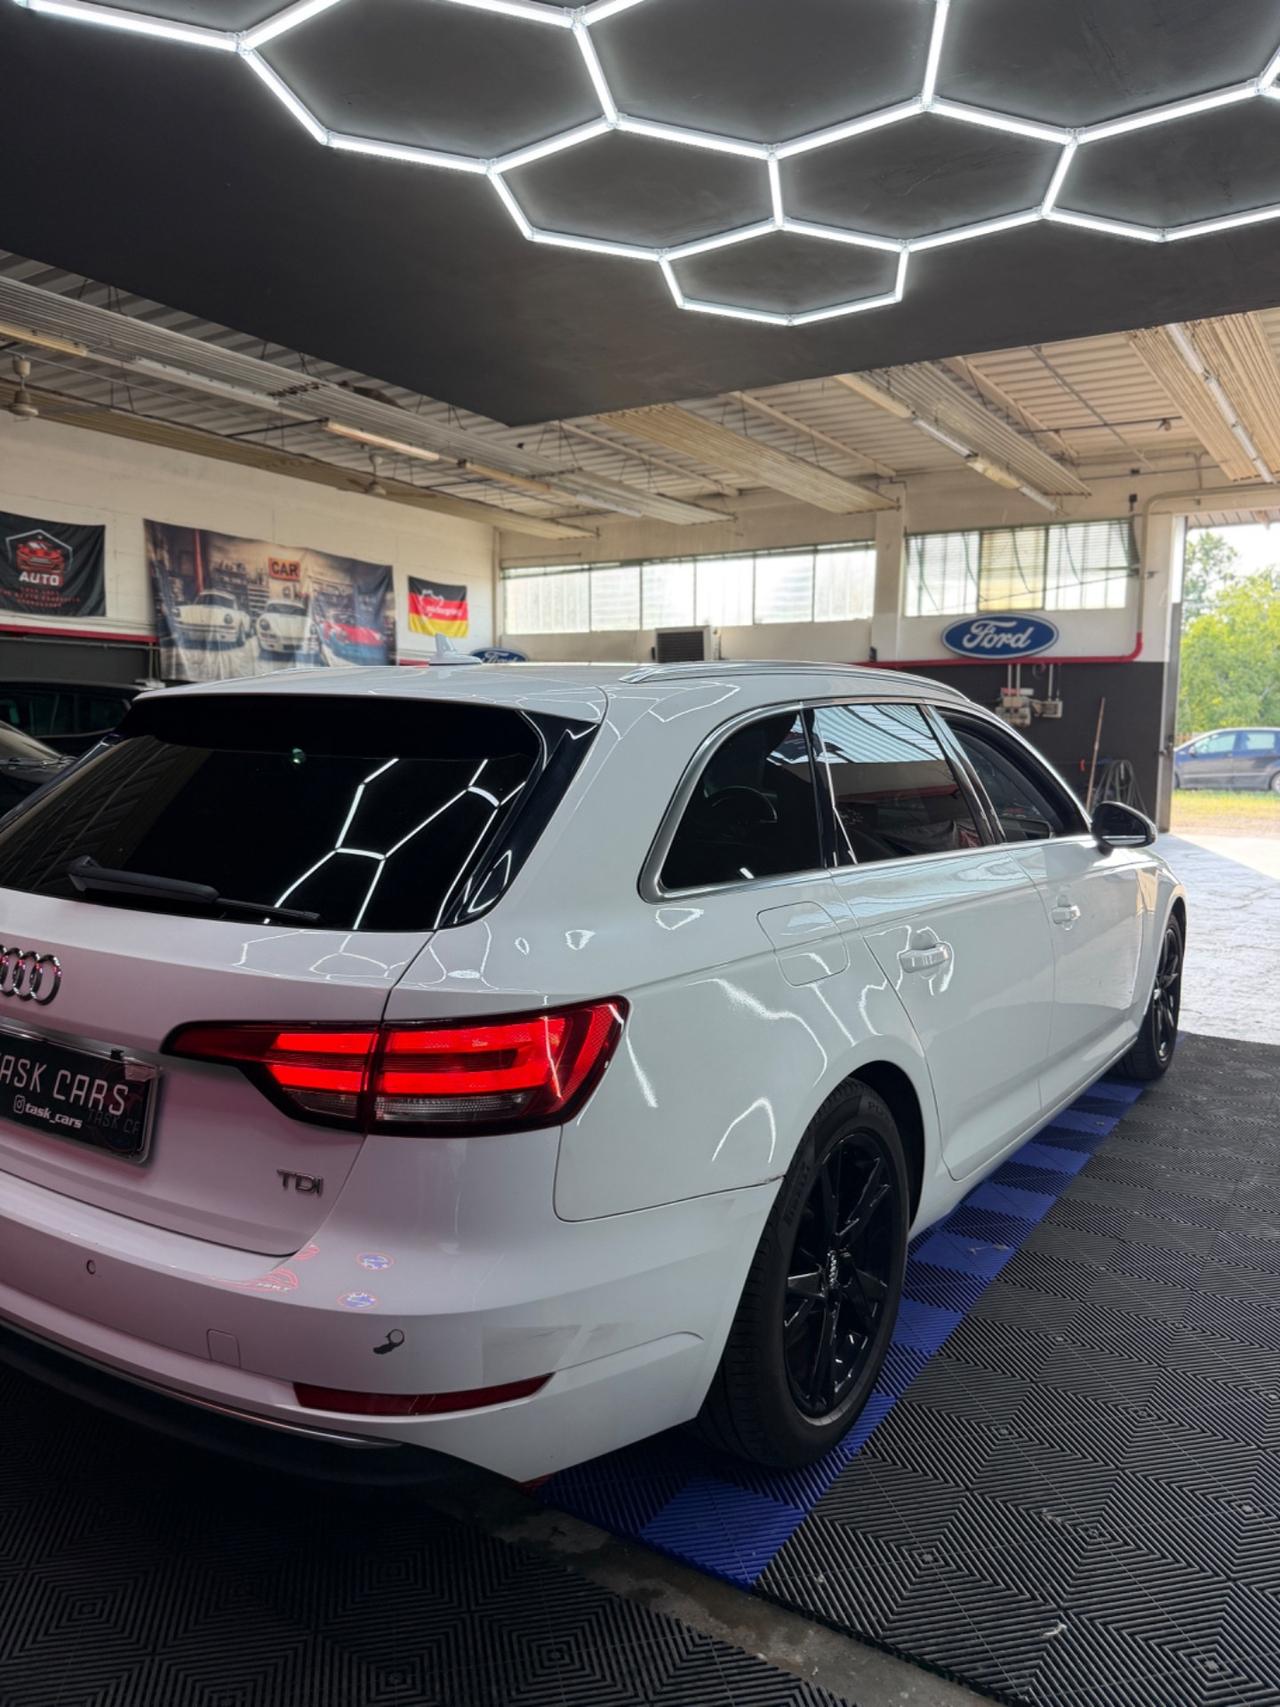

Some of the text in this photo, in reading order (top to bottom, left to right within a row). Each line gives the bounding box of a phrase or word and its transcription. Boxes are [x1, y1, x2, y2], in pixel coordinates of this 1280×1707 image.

[19, 571, 60, 587] AUTO
[271, 560, 299, 578] CAR
[962, 620, 1035, 649] Ford
[0, 1053, 129, 1116] ASK CARS
[276, 1169, 324, 1197] TDI
